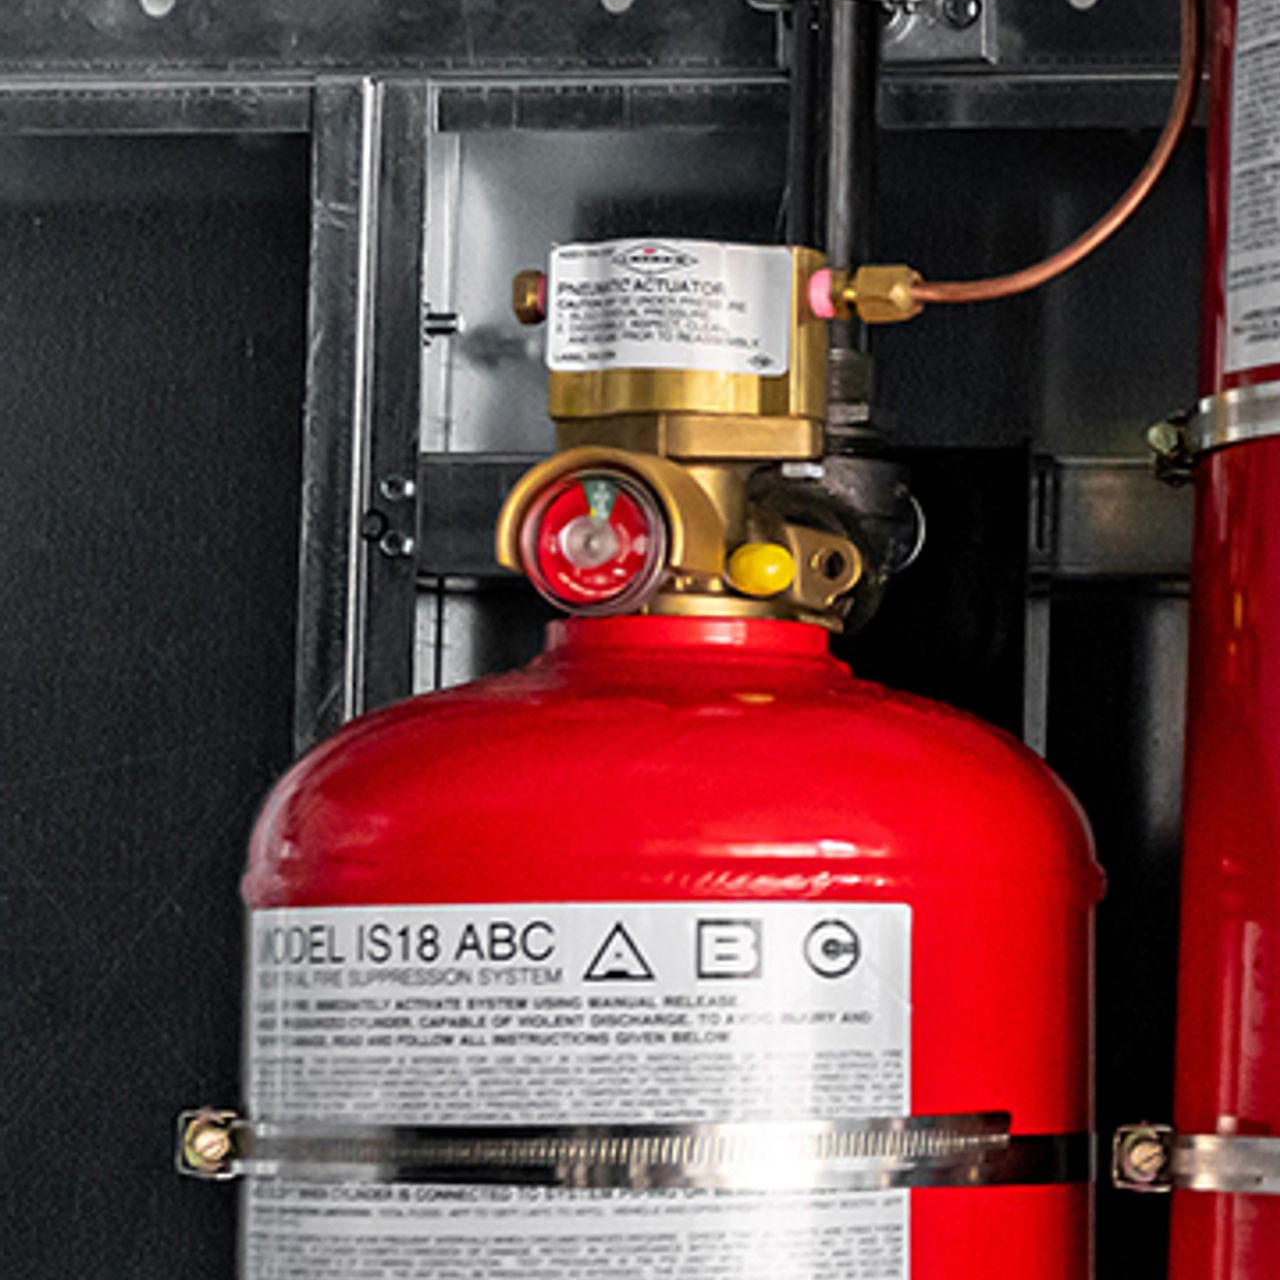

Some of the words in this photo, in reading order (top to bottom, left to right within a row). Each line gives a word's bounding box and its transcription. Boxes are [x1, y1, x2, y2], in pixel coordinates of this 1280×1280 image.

[355, 922, 443, 965] IS18
[453, 919, 557, 963] ABC
[349, 968, 473, 988] SUPPRESSION
[477, 967, 564, 987] SYSTEM
[697, 1012, 721, 1027] TO
